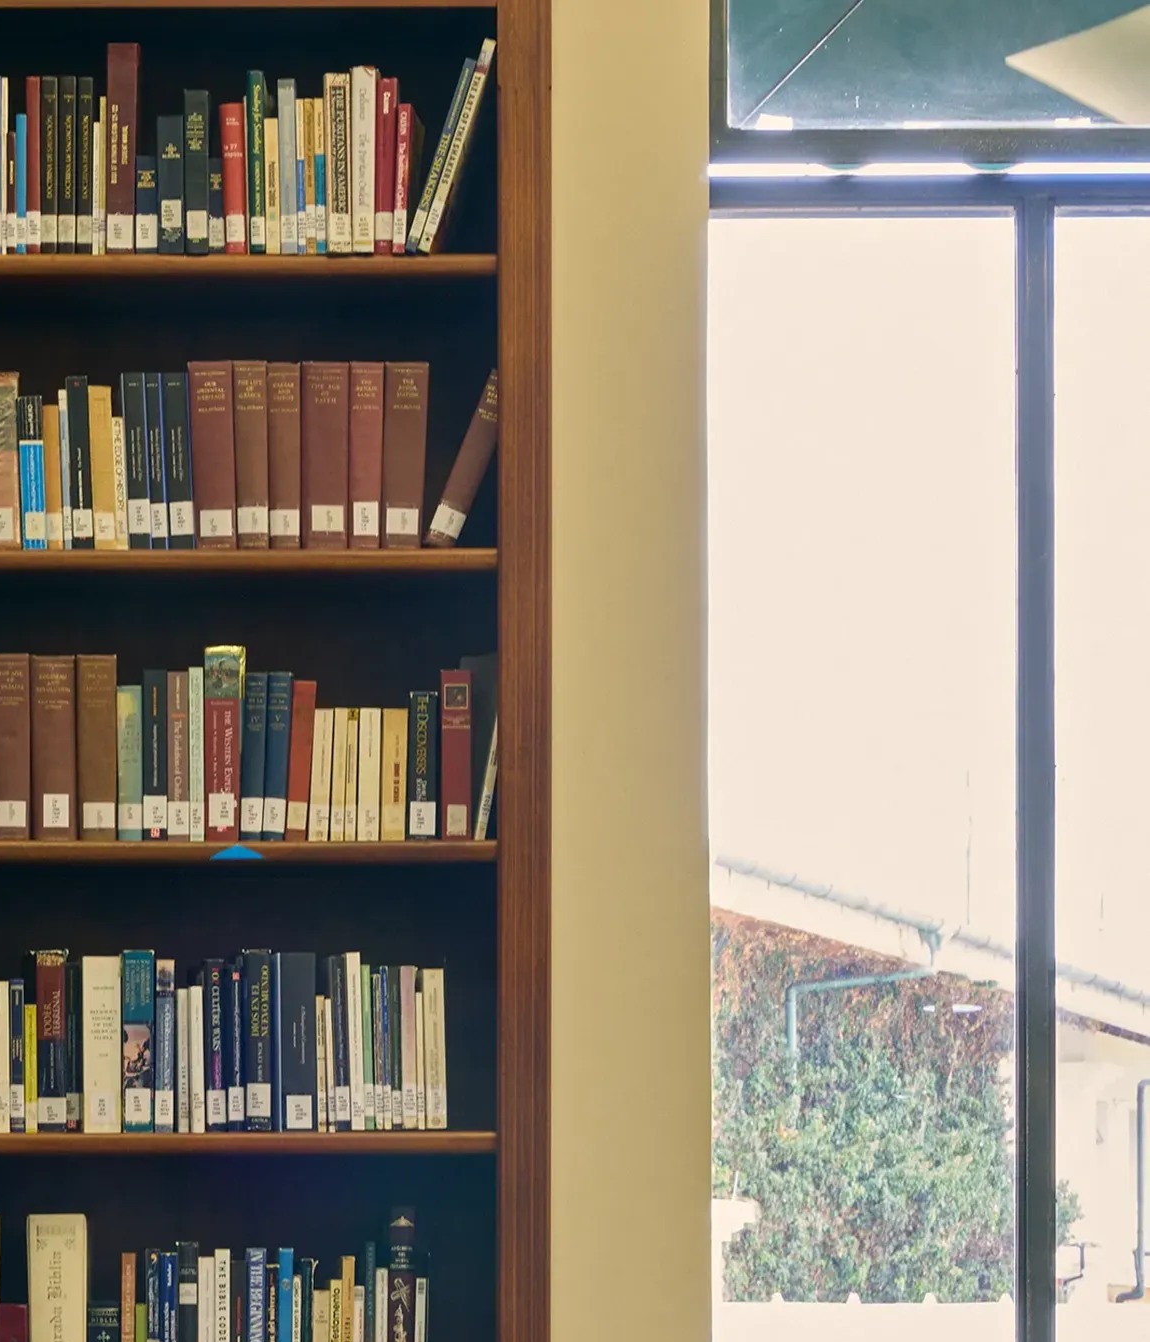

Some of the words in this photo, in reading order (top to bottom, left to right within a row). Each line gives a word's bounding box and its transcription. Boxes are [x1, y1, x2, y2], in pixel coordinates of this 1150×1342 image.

[470, 75, 482, 93] THE
[336, 88, 344, 112] THE
[336, 112, 346, 160] PURITANS
[359, 133, 369, 149] The
[436, 134, 450, 156] THE
[455, 125, 467, 142] THE
[440, 143, 462, 185] SHAKERS
[338, 171, 347, 212] AMERIC
[420, 156, 444, 208] SHAKERS
[114, 430, 122, 446] THE
[114, 446, 122, 467] EDGE
[116, 480, 124, 512] HISTORY
[417, 696, 428, 712] THE
[224, 710, 232, 726] THE
[224, 728, 232, 765] WESTERN
[416, 714, 428, 774] DISCOVERERS
[224, 768, 232, 793] EXPER
[251, 982, 258, 995] EL
[260, 964, 269, 1002] MUNDO
[52, 989, 60, 1036] TERRENAL
[212, 986, 220, 1027] CULTURE
[251, 996, 259, 1010] EN
[42, 1002, 52, 1036] PODER
[250, 1012, 260, 1036] DIOS
[260, 1002, 269, 1036] NUEVO
[212, 1028, 220, 1051] WARS
[249, 1248, 264, 1262] IN
[46, 1251, 64, 1300] Biblia
[218, 1260, 226, 1278] THE
[249, 1263, 264, 1286] THE
[218, 1284, 226, 1312] BIBLE
[90, 1316, 118, 1324] BIBLIA
[218, 1316, 226, 1342] CODE
